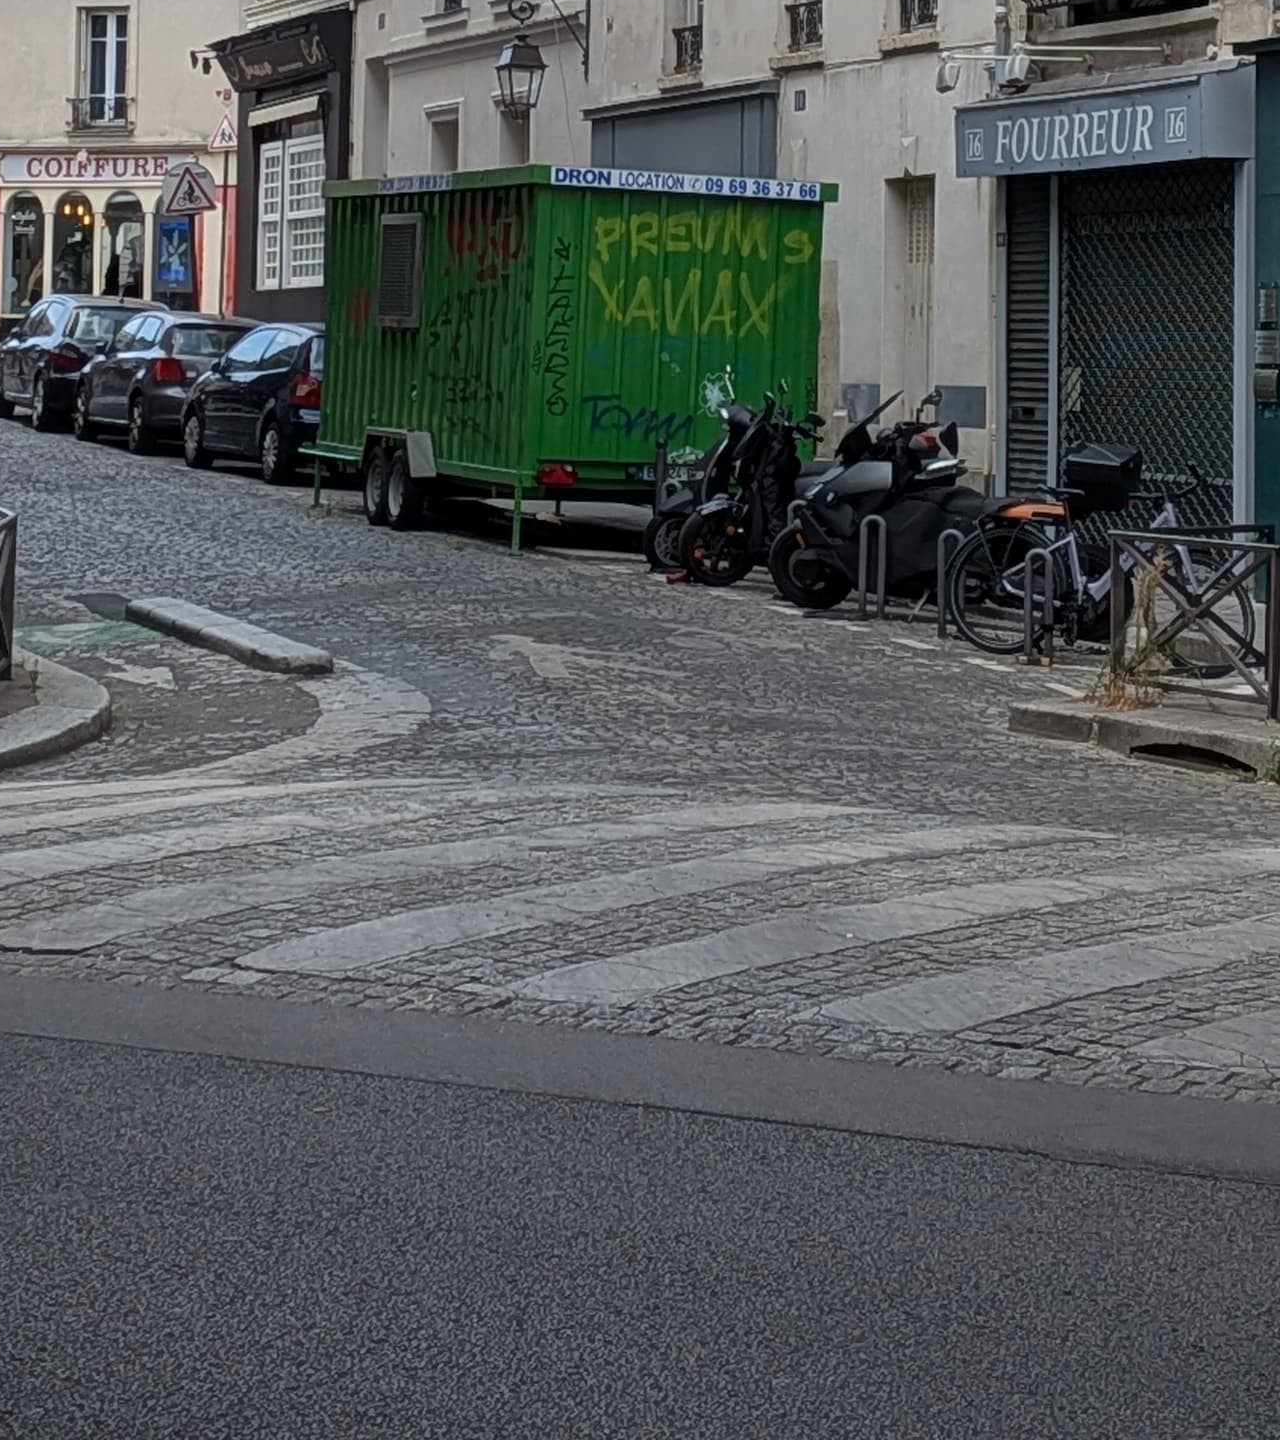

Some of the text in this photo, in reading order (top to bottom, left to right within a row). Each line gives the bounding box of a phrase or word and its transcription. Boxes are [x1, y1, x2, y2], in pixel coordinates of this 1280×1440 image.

[968, 105, 1185, 164] 16 FOURREUR 16
[28, 158, 168, 177] COIFFURE
[554, 168, 818, 199] DRON LOCATION 09 69 36 37 66
